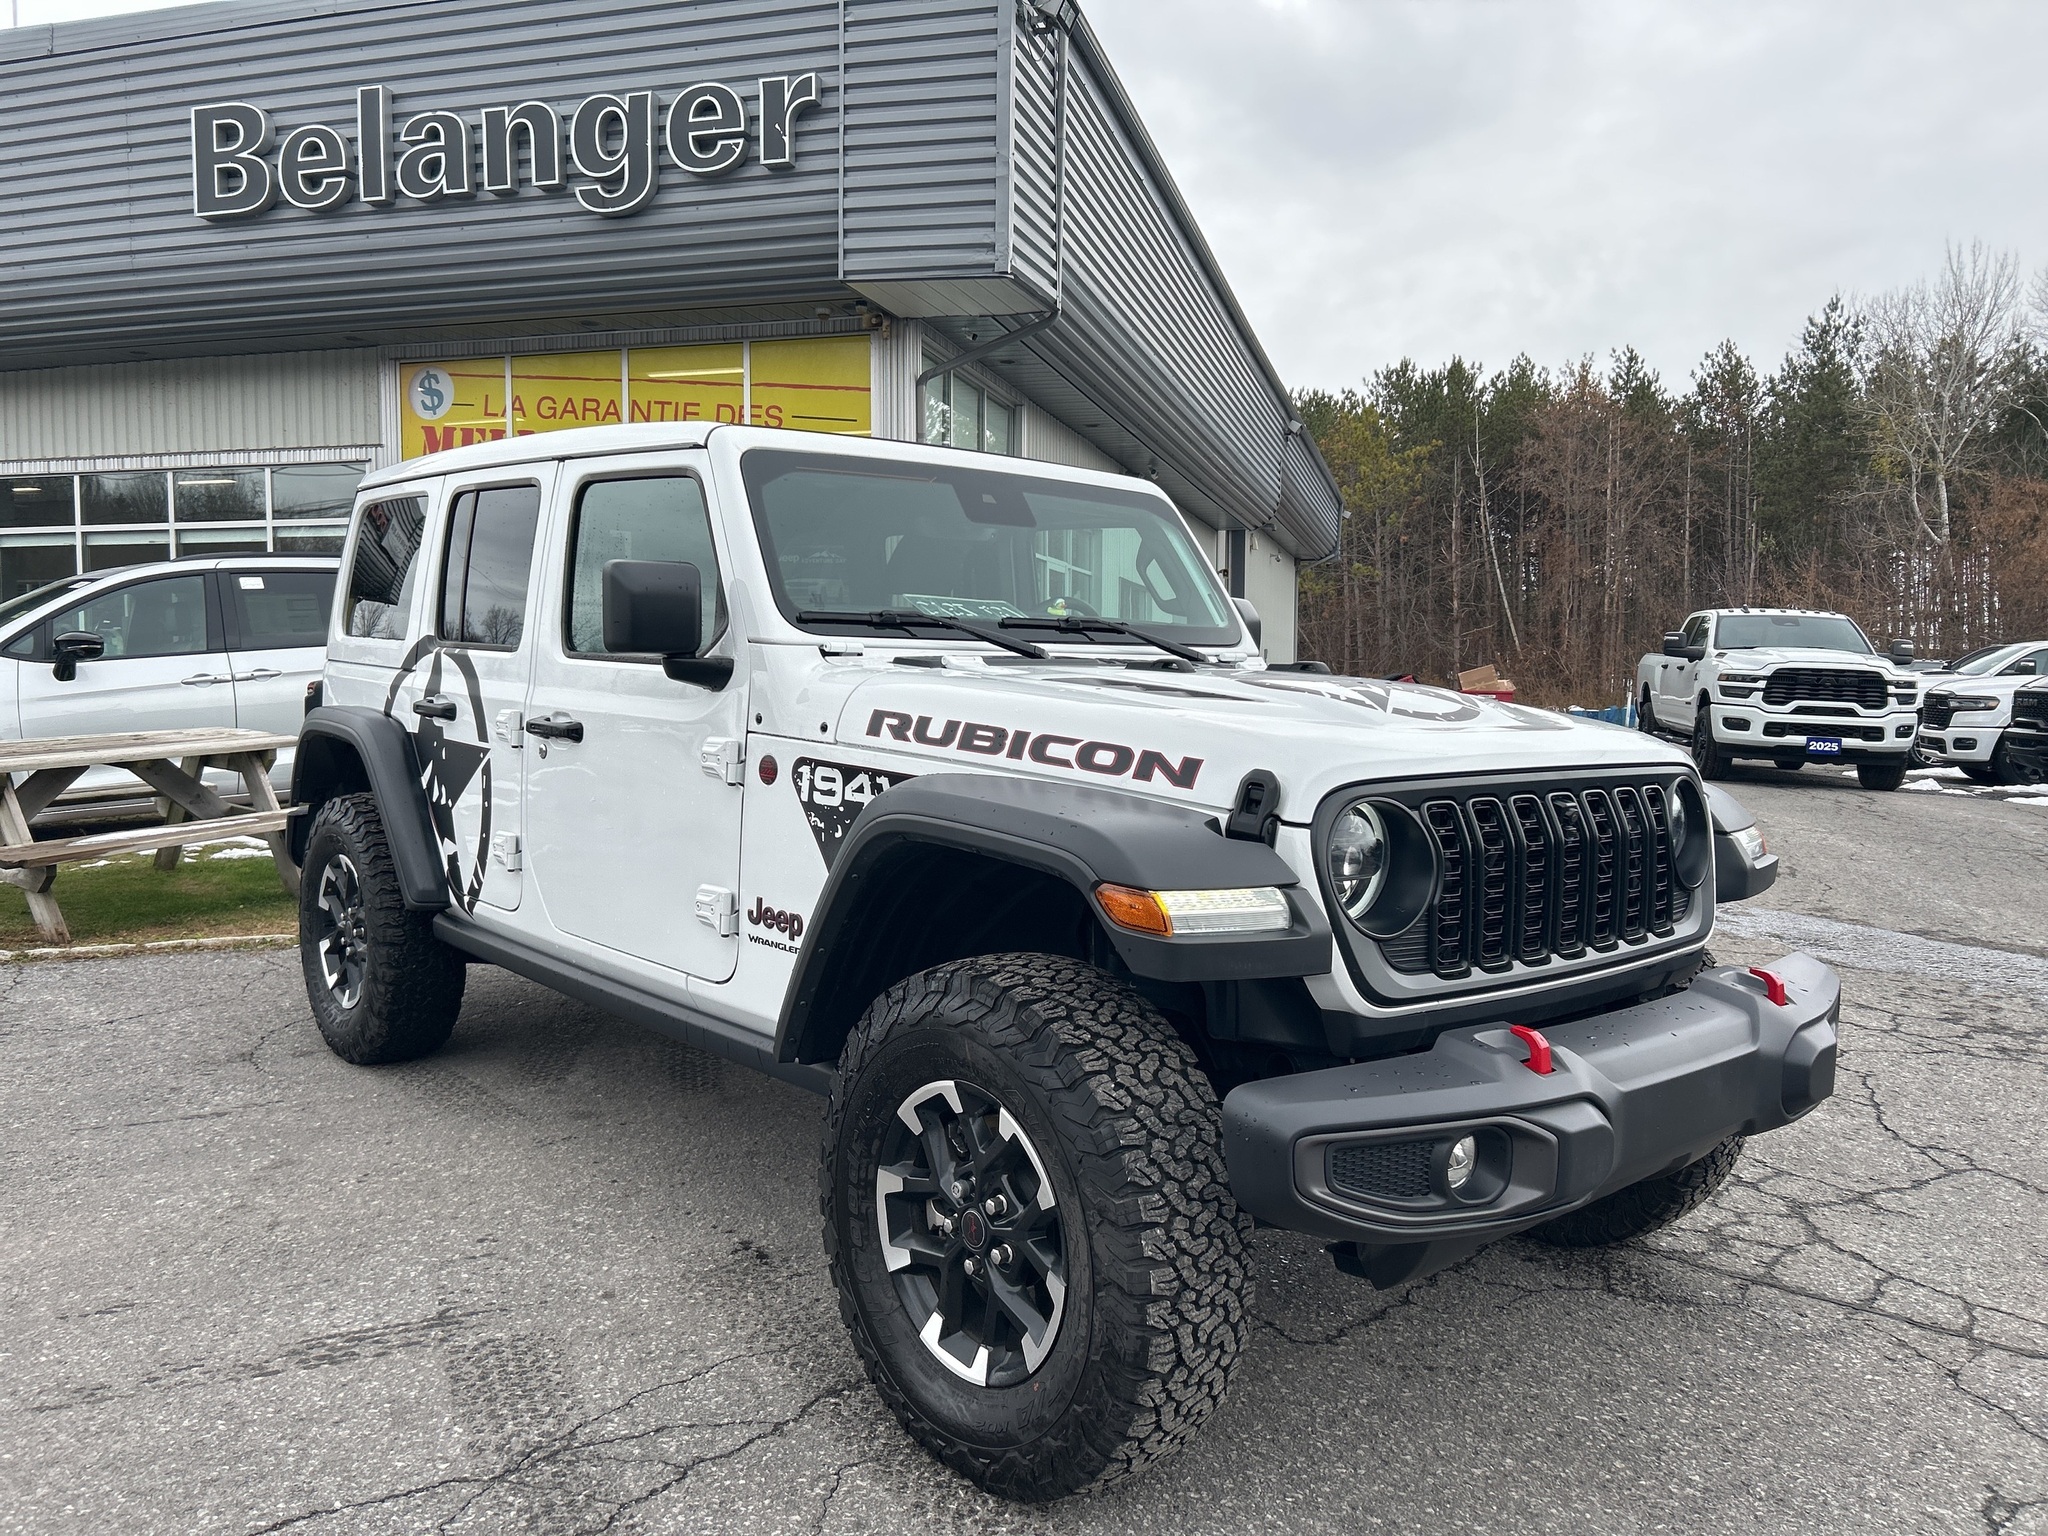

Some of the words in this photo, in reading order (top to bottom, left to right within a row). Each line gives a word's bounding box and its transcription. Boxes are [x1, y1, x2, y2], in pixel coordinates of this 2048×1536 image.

[190, 72, 821, 218] Belanger
[483, 393, 527, 419] LA
[535, 394, 701, 424] GARANTIE
[714, 403, 784, 429] DES
[865, 708, 1205, 790] RUBICON
[1808, 740, 1840, 752] 2025
[747, 896, 804, 942] Jeep
